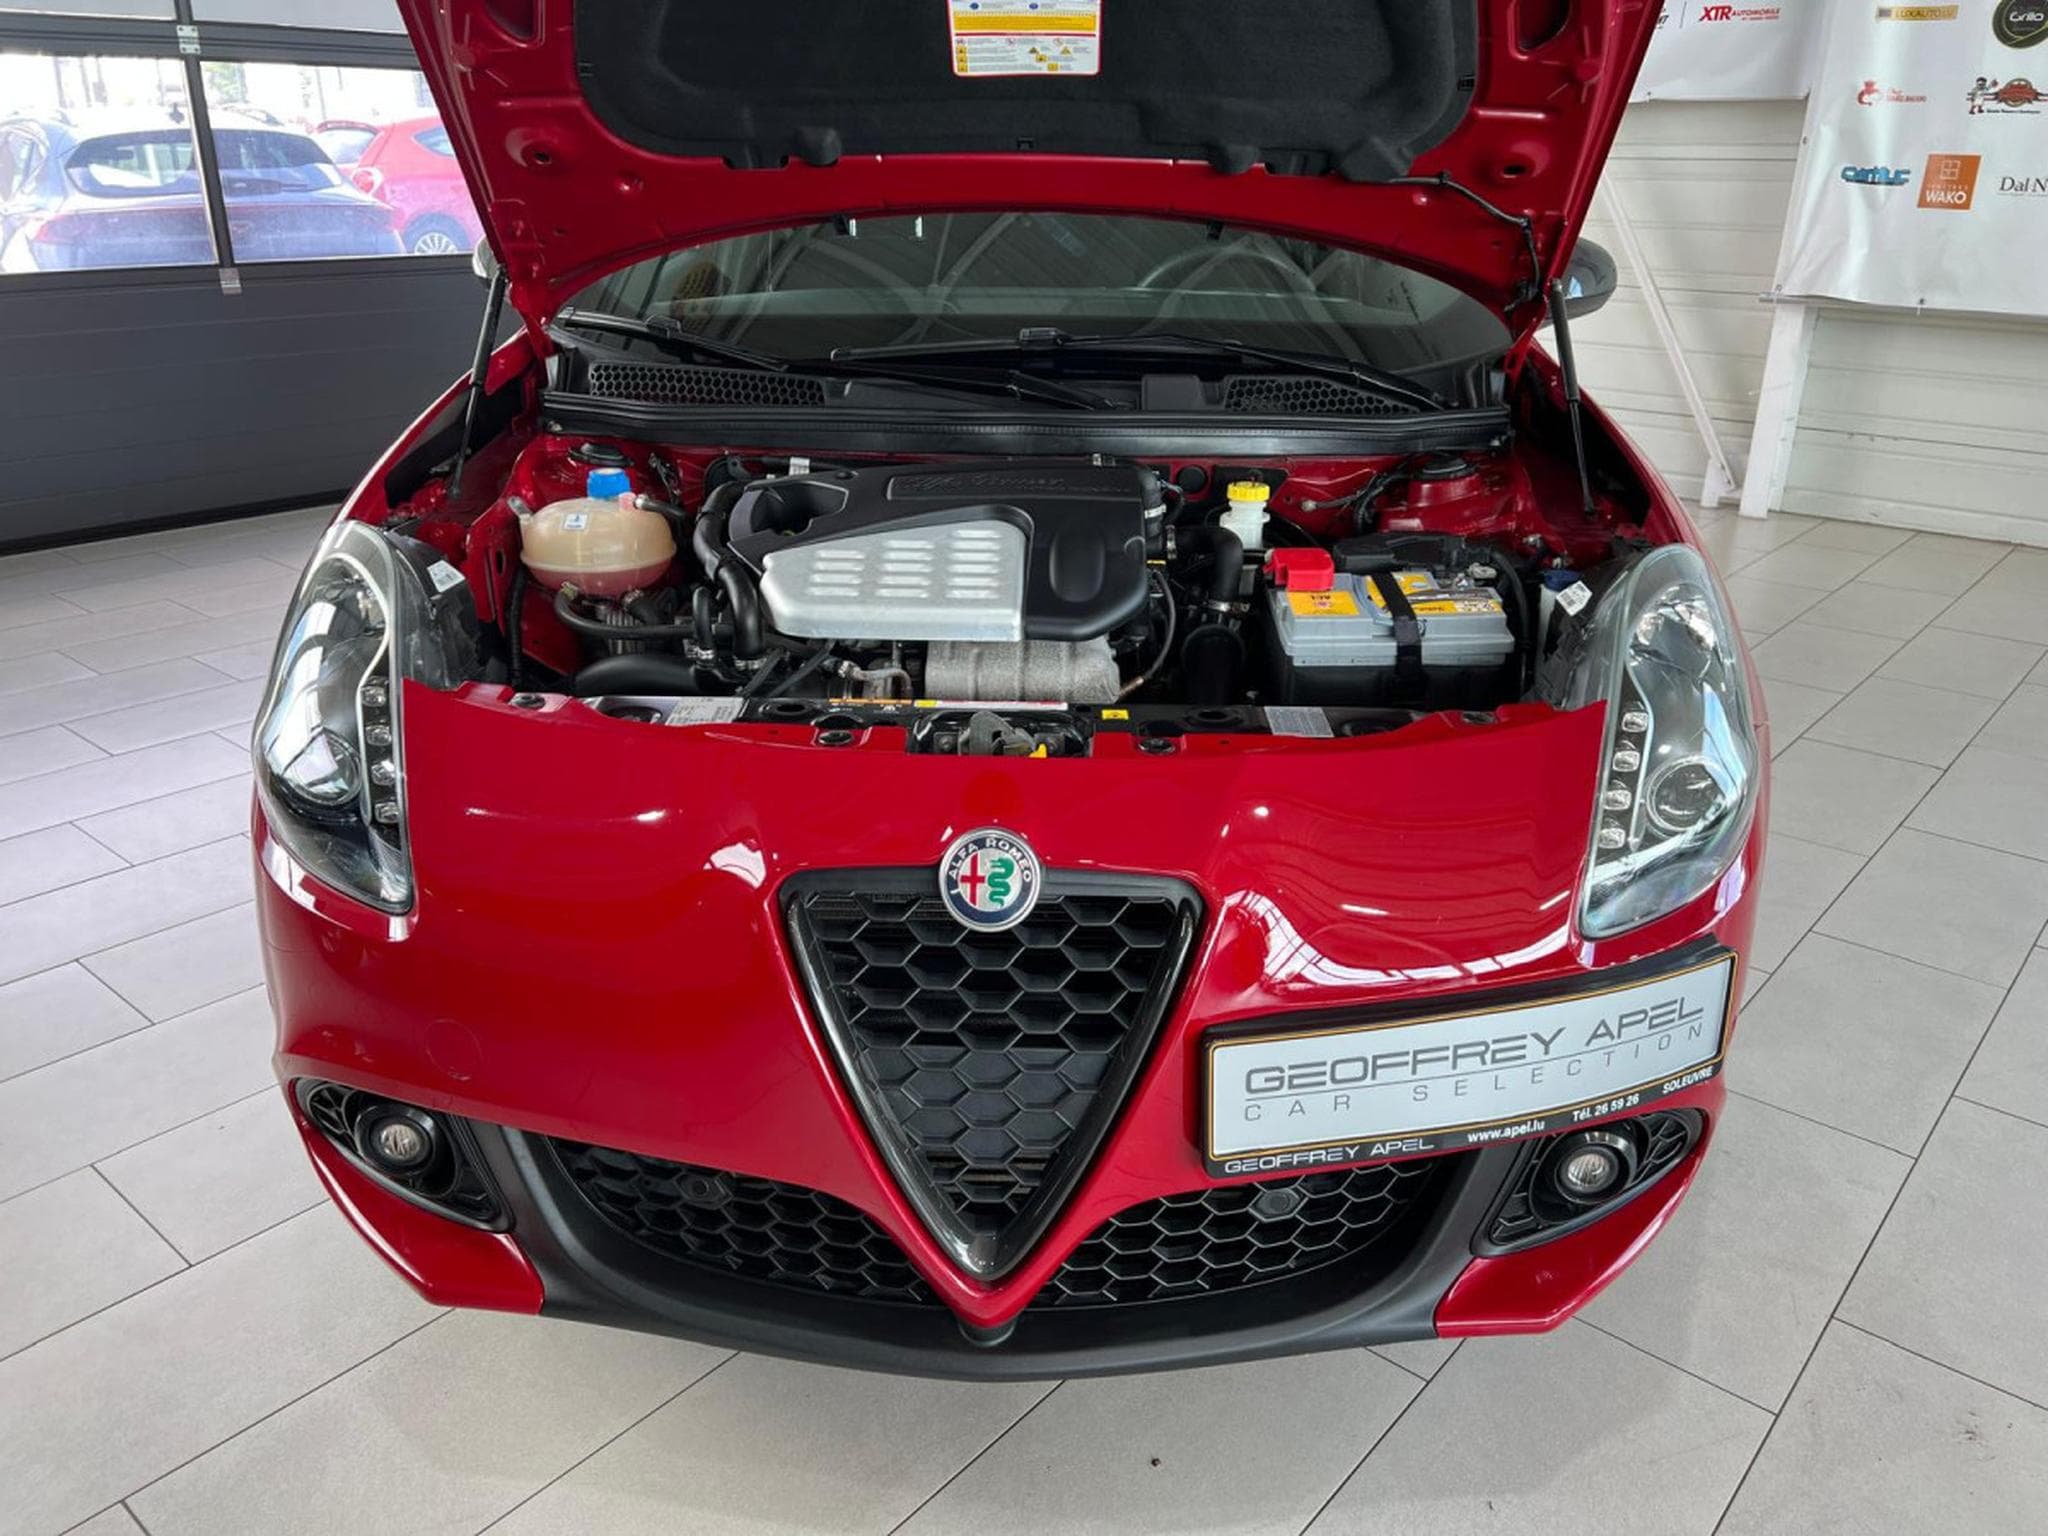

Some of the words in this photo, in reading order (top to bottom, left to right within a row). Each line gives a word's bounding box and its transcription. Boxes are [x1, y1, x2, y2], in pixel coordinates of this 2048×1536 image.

[1699, 6, 1732, 21] XTR
[1926, 190, 1968, 204] WAKO
[2000, 176, 2030, 192] Dal
[949, 842, 979, 880] ALFA
[985, 837, 1032, 883] ROMEO
[1245, 1026, 1567, 1095] GEOFFREY
[1585, 996, 1704, 1047] APEL
[1244, 1094, 1351, 1121] CAR
[1412, 1022, 1703, 1102] SELECTION
[1224, 1145, 1360, 1174] GEOFFREY
[1370, 1138, 1434, 1157] APEL
[1467, 1119, 1545, 1143] www.apel.lu
[1594, 1104, 1609, 1118] 26
[1610, 1099, 1625, 1114] 59
[1626, 1093, 1640, 1108] 26
[1661, 1066, 1714, 1095] SOLEUVRE
